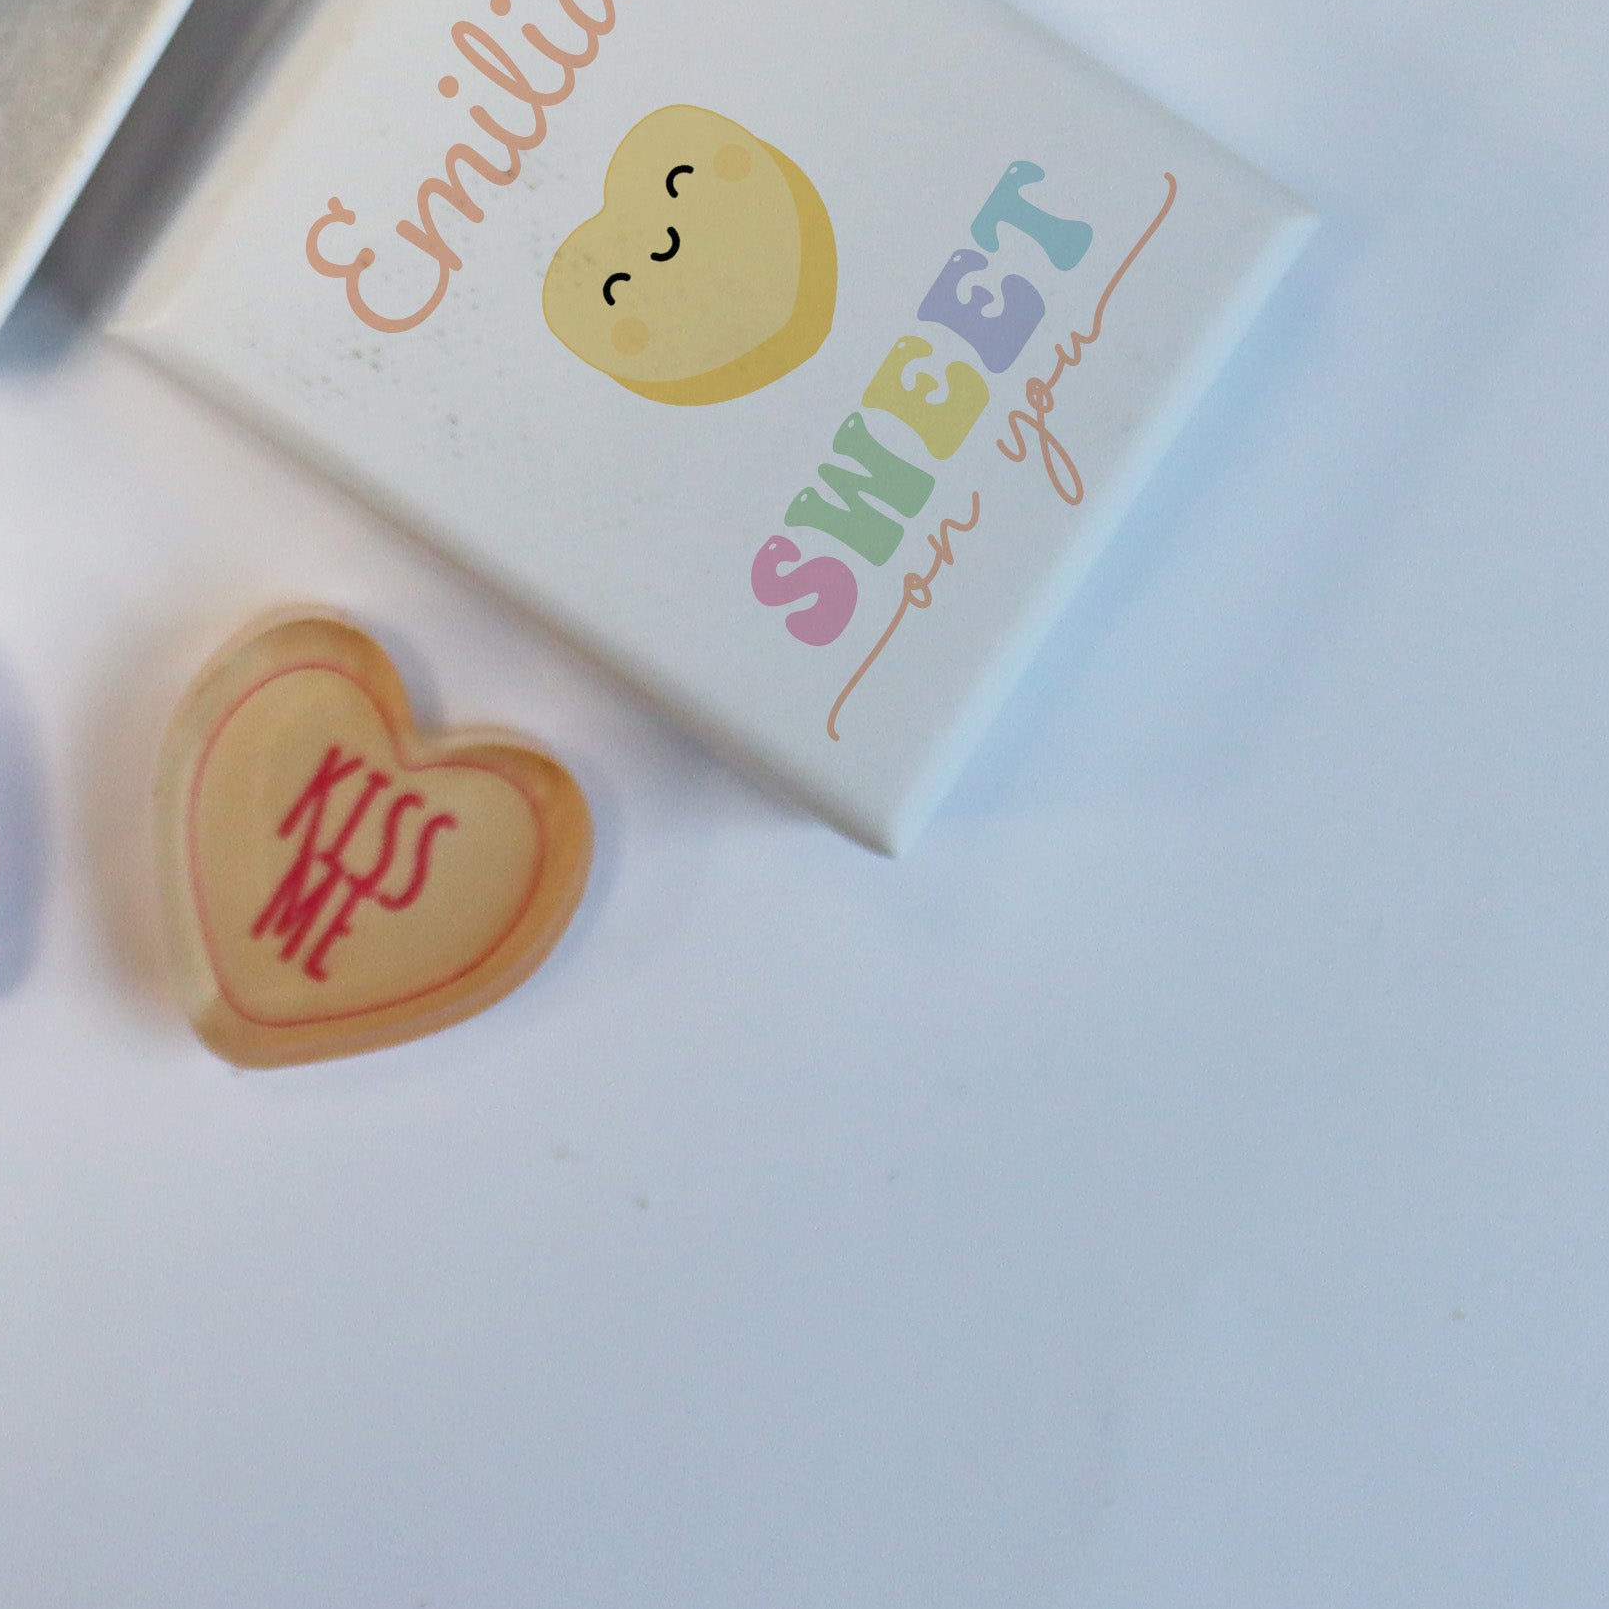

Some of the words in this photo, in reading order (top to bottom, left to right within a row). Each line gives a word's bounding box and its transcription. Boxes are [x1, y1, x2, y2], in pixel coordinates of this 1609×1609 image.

[751, 160, 1094, 647] SWEET
[996, 172, 1177, 506] you
[250, 851, 364, 981] ME
[277, 744, 456, 911] KISS
